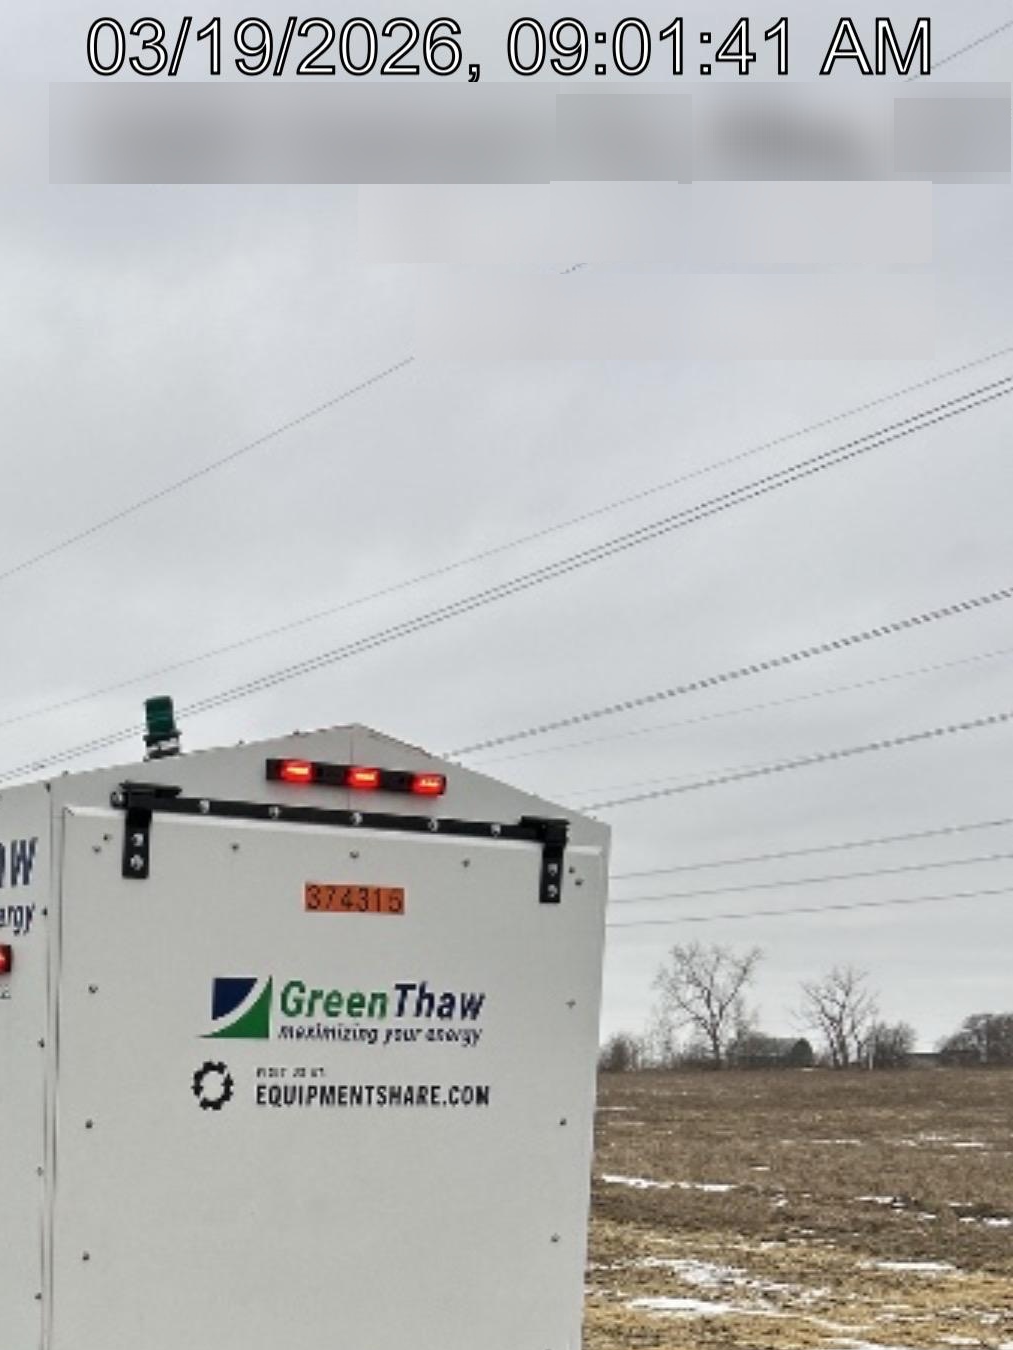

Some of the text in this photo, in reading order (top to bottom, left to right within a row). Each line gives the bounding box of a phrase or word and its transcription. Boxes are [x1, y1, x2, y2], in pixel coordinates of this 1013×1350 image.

[307, 885, 402, 913] 374315
[277, 1023, 378, 1045] maximizing
[256, 1084, 490, 1107] EQUIPMENTSHARE.COM
